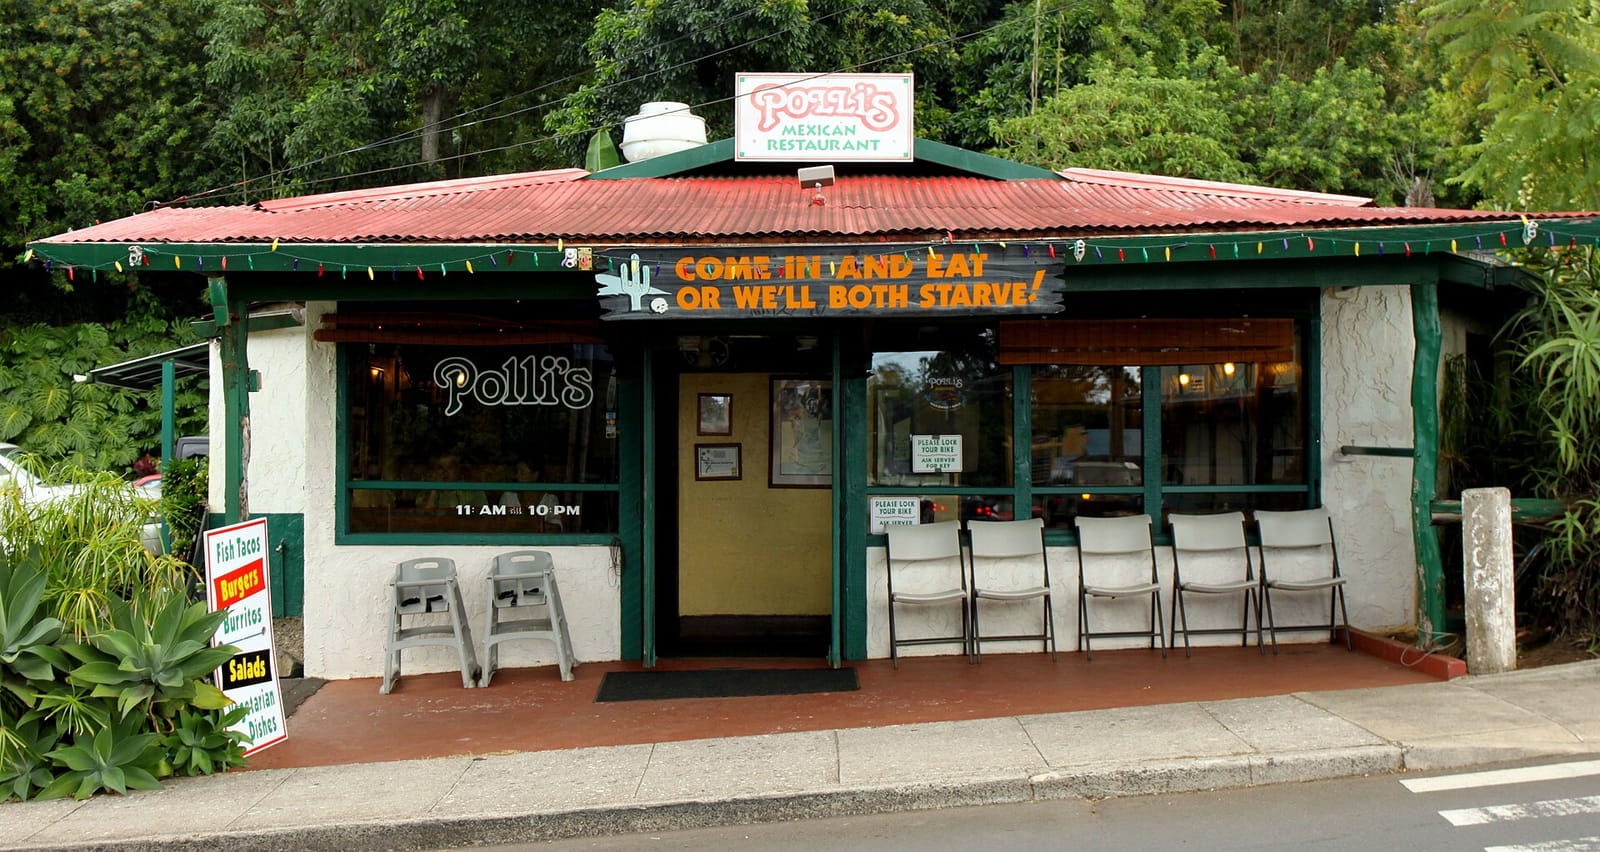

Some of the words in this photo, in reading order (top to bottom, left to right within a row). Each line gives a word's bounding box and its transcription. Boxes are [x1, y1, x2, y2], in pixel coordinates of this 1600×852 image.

[781, 124, 857, 136] MEXICAN
[767, 139, 881, 151] RESTAURANT
[675, 256, 771, 281] COME
[784, 255, 821, 280] IN
[836, 255, 914, 280] AND
[926, 252, 989, 278] EAT
[676, 286, 720, 311] OR
[732, 284, 817, 310] WE'LL
[828, 284, 909, 310] BOTH
[919, 269, 1047, 309] STARVE!
[433, 355, 594, 416] Polli's
[455, 504, 475, 516] 11:
[479, 504, 507, 516] AM
[216, 538, 235, 564] Fish
[236, 536, 260, 558] Tacos
[220, 569, 259, 603] Burgers
[223, 606, 262, 635] Burritos
[229, 655, 266, 682] Salads
[248, 715, 277, 741] Dishes
